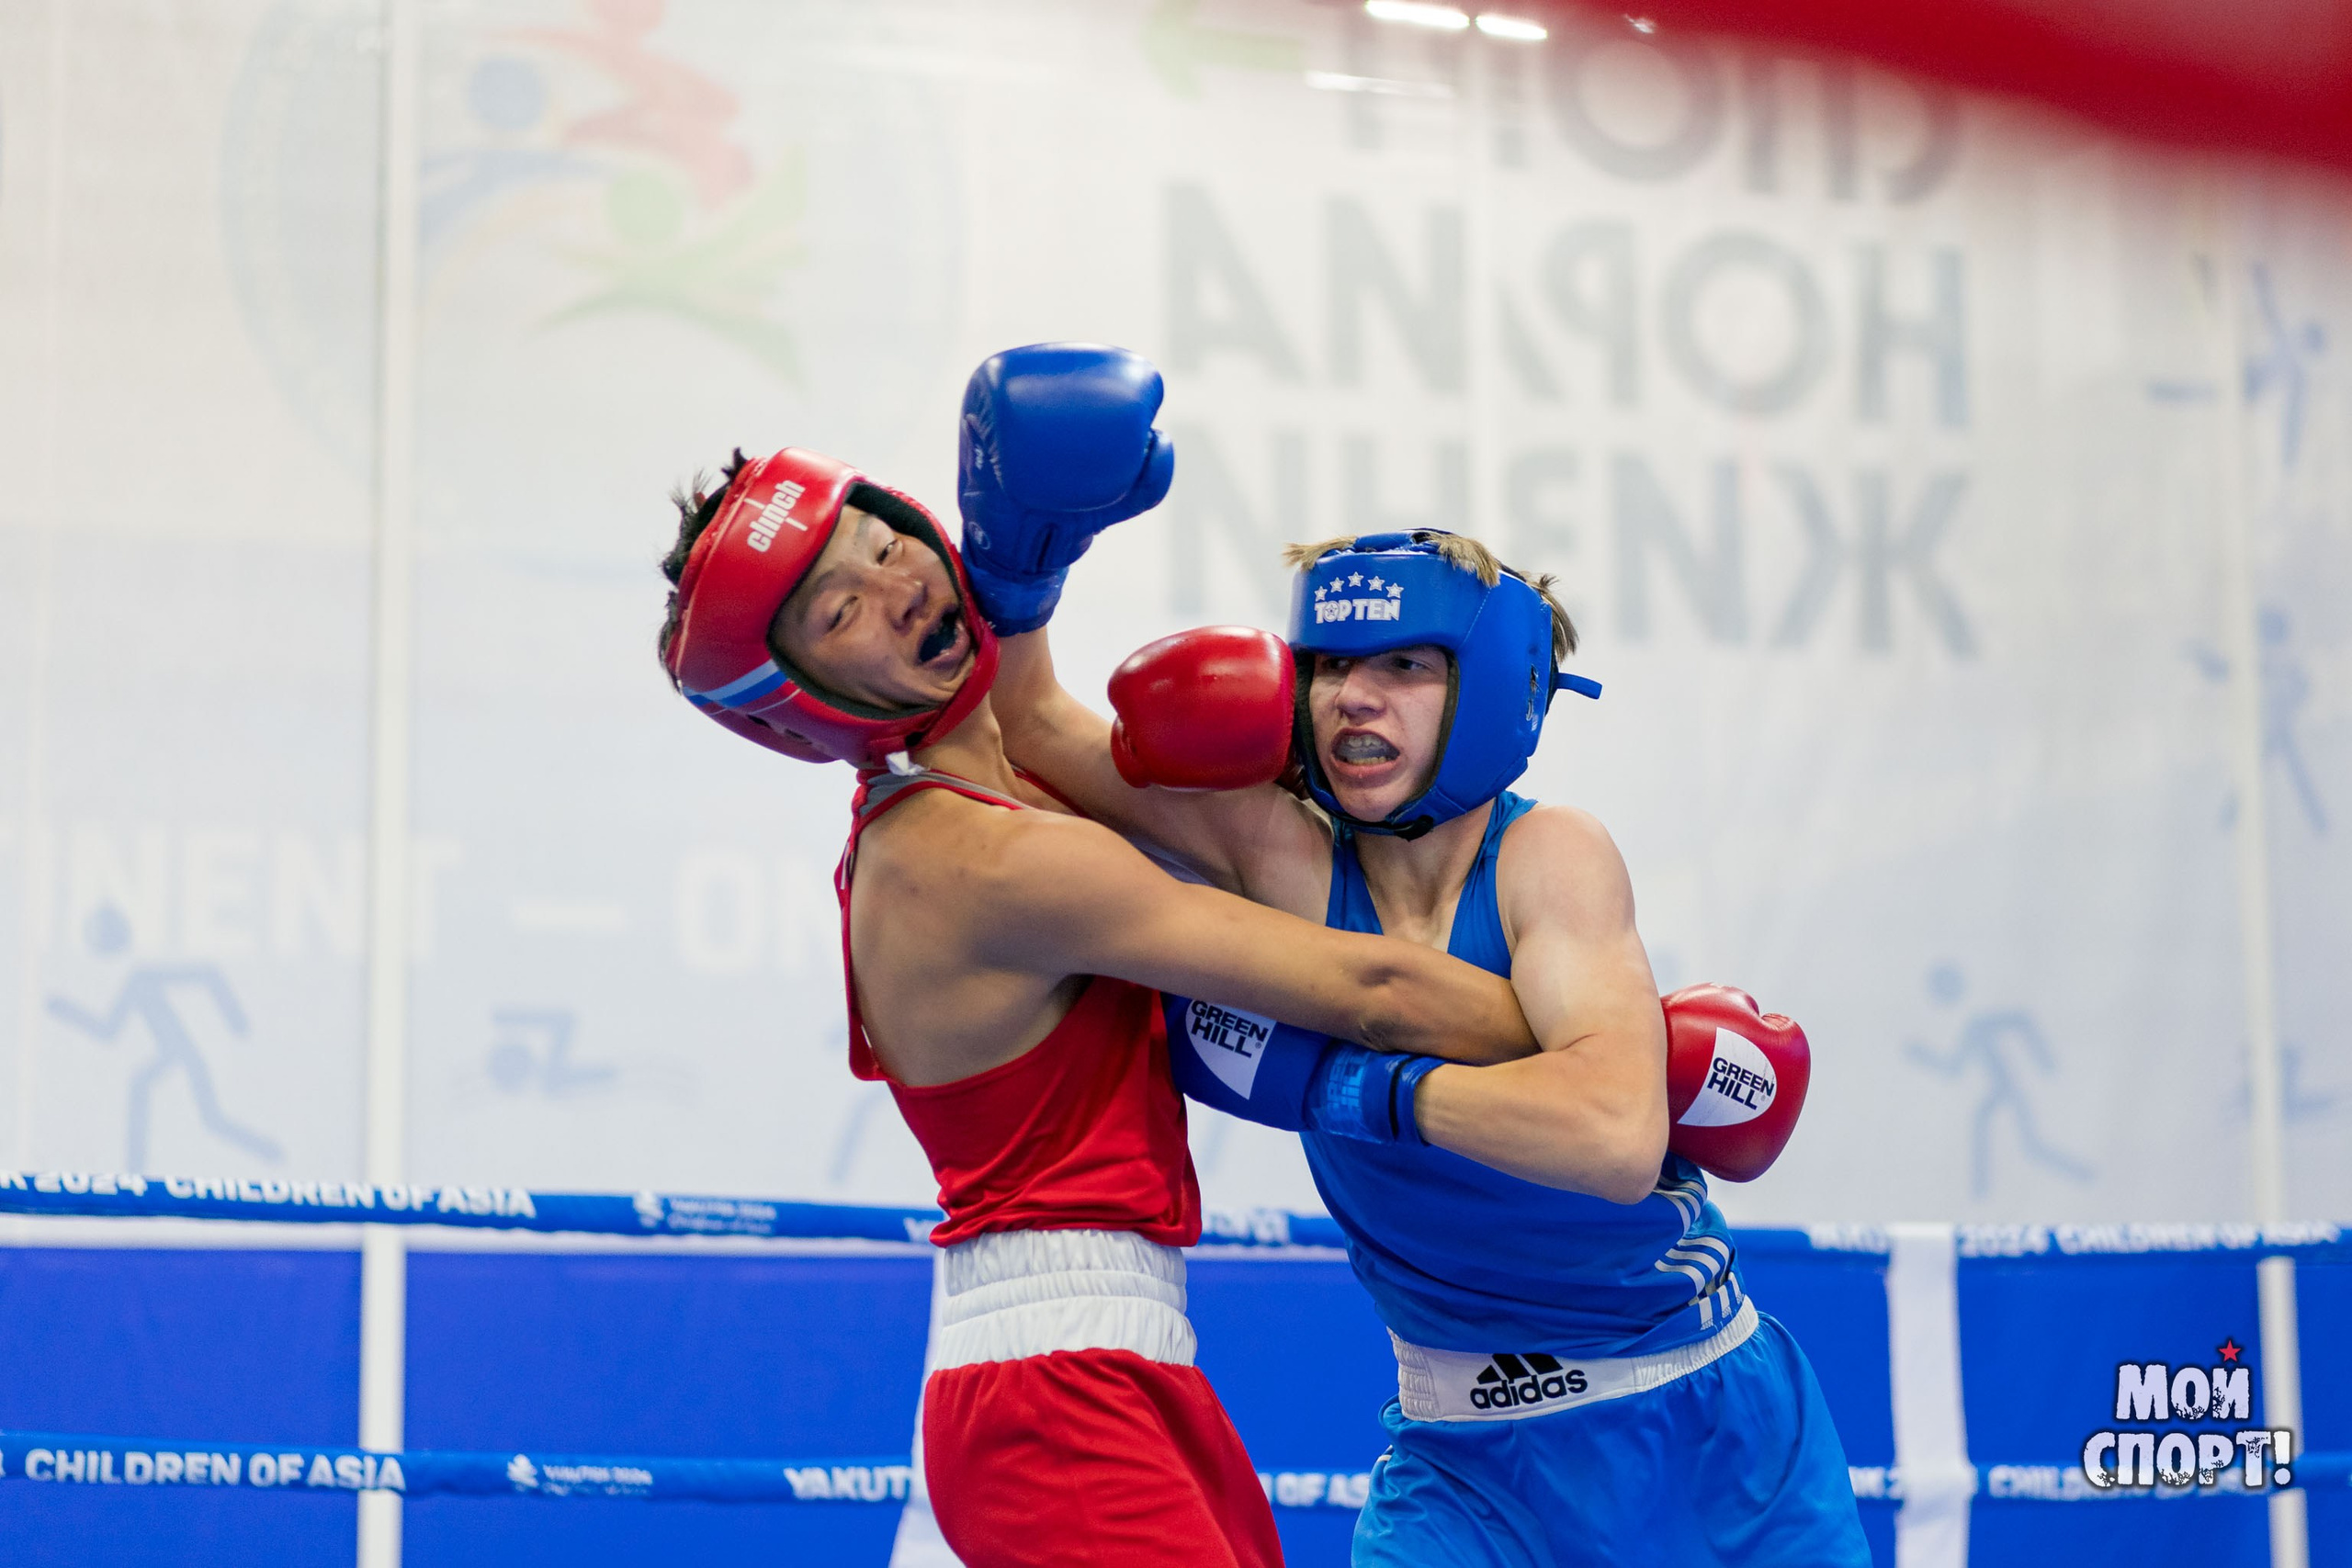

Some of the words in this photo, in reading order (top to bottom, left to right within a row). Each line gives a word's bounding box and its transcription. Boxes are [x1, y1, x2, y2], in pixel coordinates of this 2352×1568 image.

[746, 479, 807, 553] clinch
[1191, 1000, 1269, 1043] GREEN
[1192, 1016, 1252, 1059] HILL
[1706, 1073, 1758, 1111] HILL
[1713, 1057, 1774, 1097] GREEN
[436, 1185, 538, 1220] ASIA
[1470, 1369, 1589, 1410] adidas
[25, 1448, 242, 1485] CHILDREN
[248, 1452, 305, 1487] OF
[306, 1454, 406, 1491] ASIA
